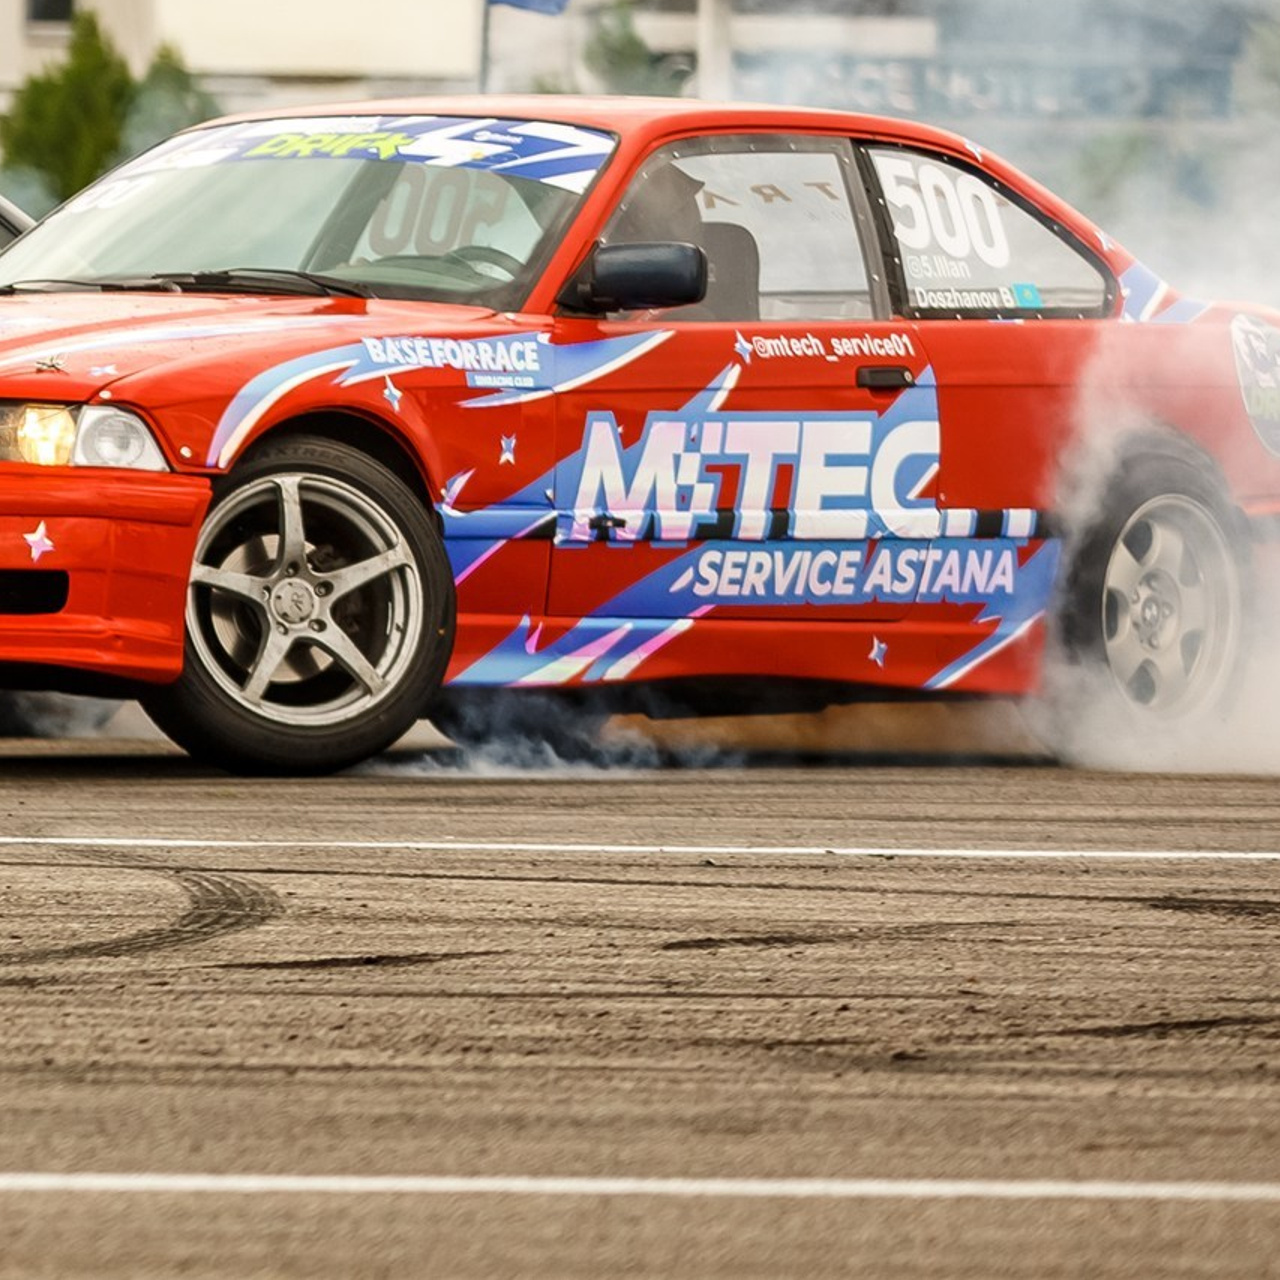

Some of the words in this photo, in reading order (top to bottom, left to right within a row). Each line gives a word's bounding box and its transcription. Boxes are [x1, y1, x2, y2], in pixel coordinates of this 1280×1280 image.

[243, 131, 417, 161] DRIFT
[874, 155, 1010, 269] 500
[915, 286, 997, 308] Doszhanov
[998, 287, 1015, 308] B
[693, 550, 861, 595] SERVICE
[863, 549, 1014, 595] ASTANA
